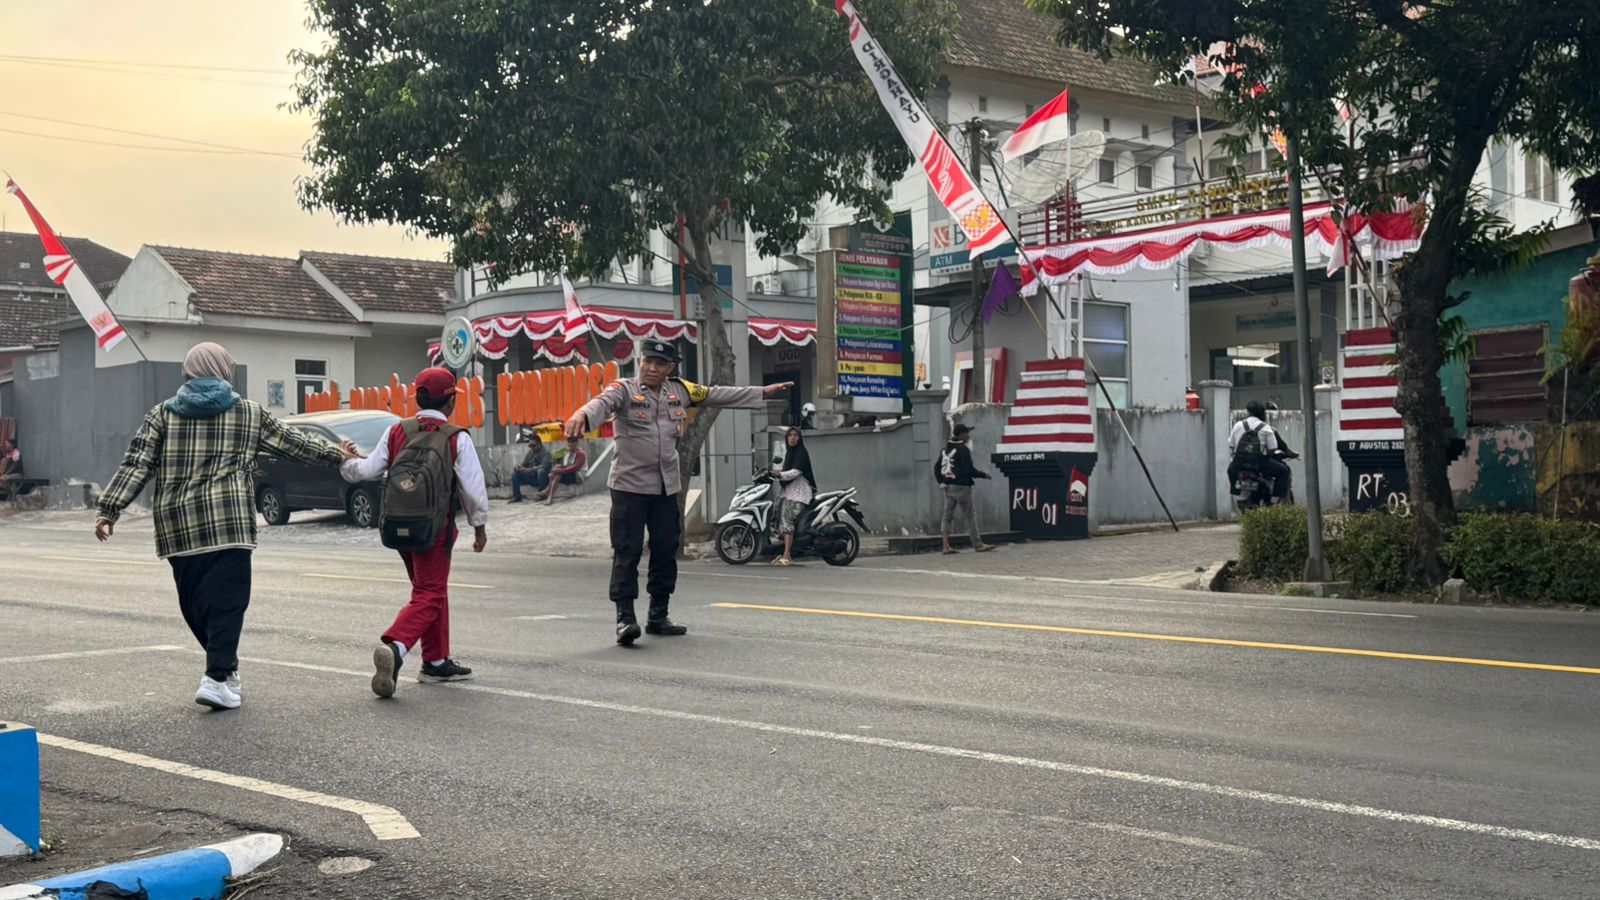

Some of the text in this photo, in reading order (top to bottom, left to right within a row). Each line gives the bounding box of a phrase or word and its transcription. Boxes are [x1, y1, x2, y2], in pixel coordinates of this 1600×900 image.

[838, 253, 888, 266] JENIS PELAYANAN
[935, 256, 952, 267] ATM
[844, 338, 866, 348] Pelayanan
[779, 348, 801, 361] UGD
[844, 350, 866, 360] Pelayanan
[866, 352, 883, 360] Farmasi
[847, 376, 866, 384] Pelayanan
[1349, 442, 1356, 450] 17
[1359, 442, 1389, 450] AGUSTUS
[1357, 473, 1411, 517] RT 03
[1012, 487, 1038, 511] RW
[1041, 503, 1057, 526] 01
